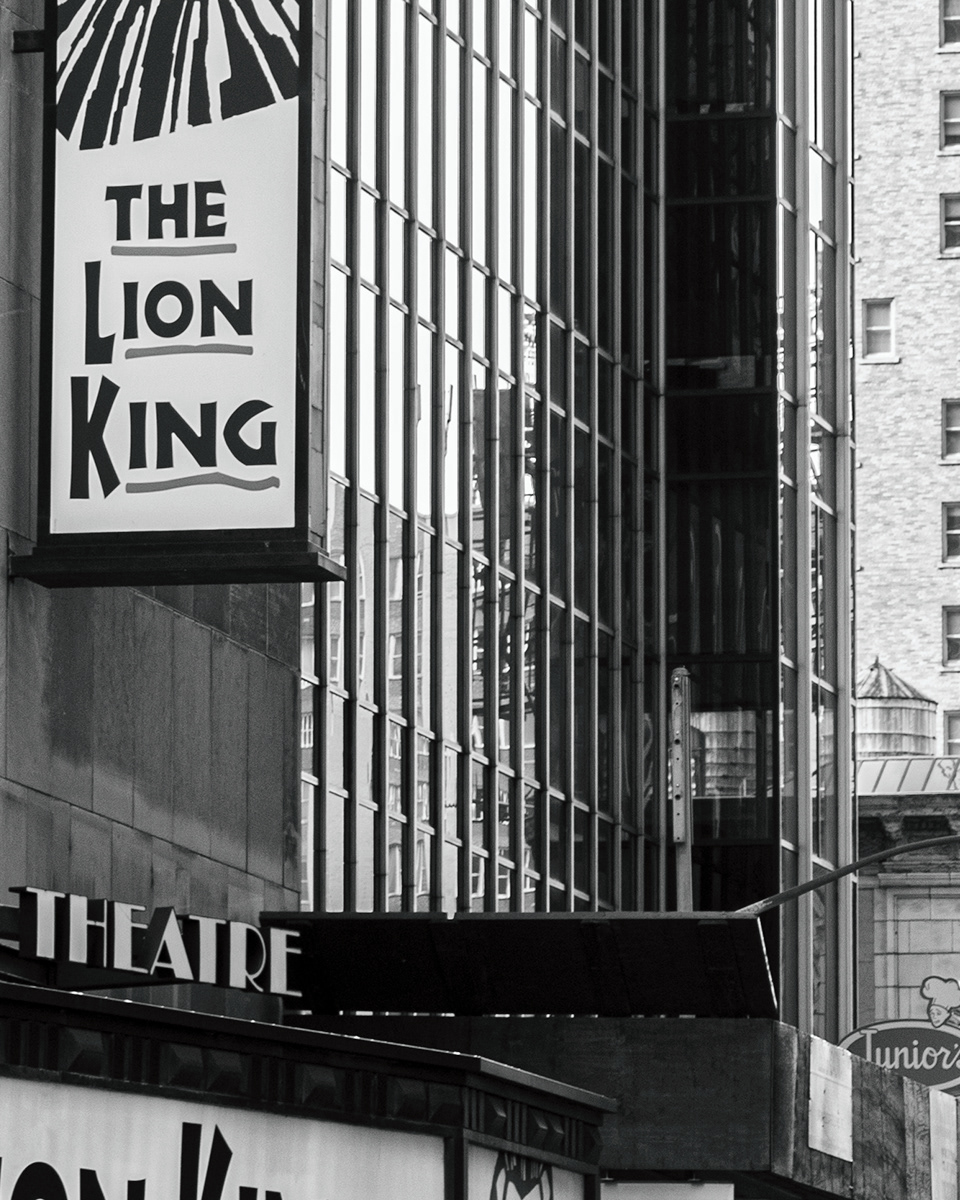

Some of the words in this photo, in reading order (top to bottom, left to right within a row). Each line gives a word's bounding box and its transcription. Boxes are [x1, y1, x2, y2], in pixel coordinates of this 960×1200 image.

[105, 180, 227, 240] THE
[84, 260, 253, 364] LION
[69, 374, 278, 499] KING
[24, 886, 303, 998] THEATRE
